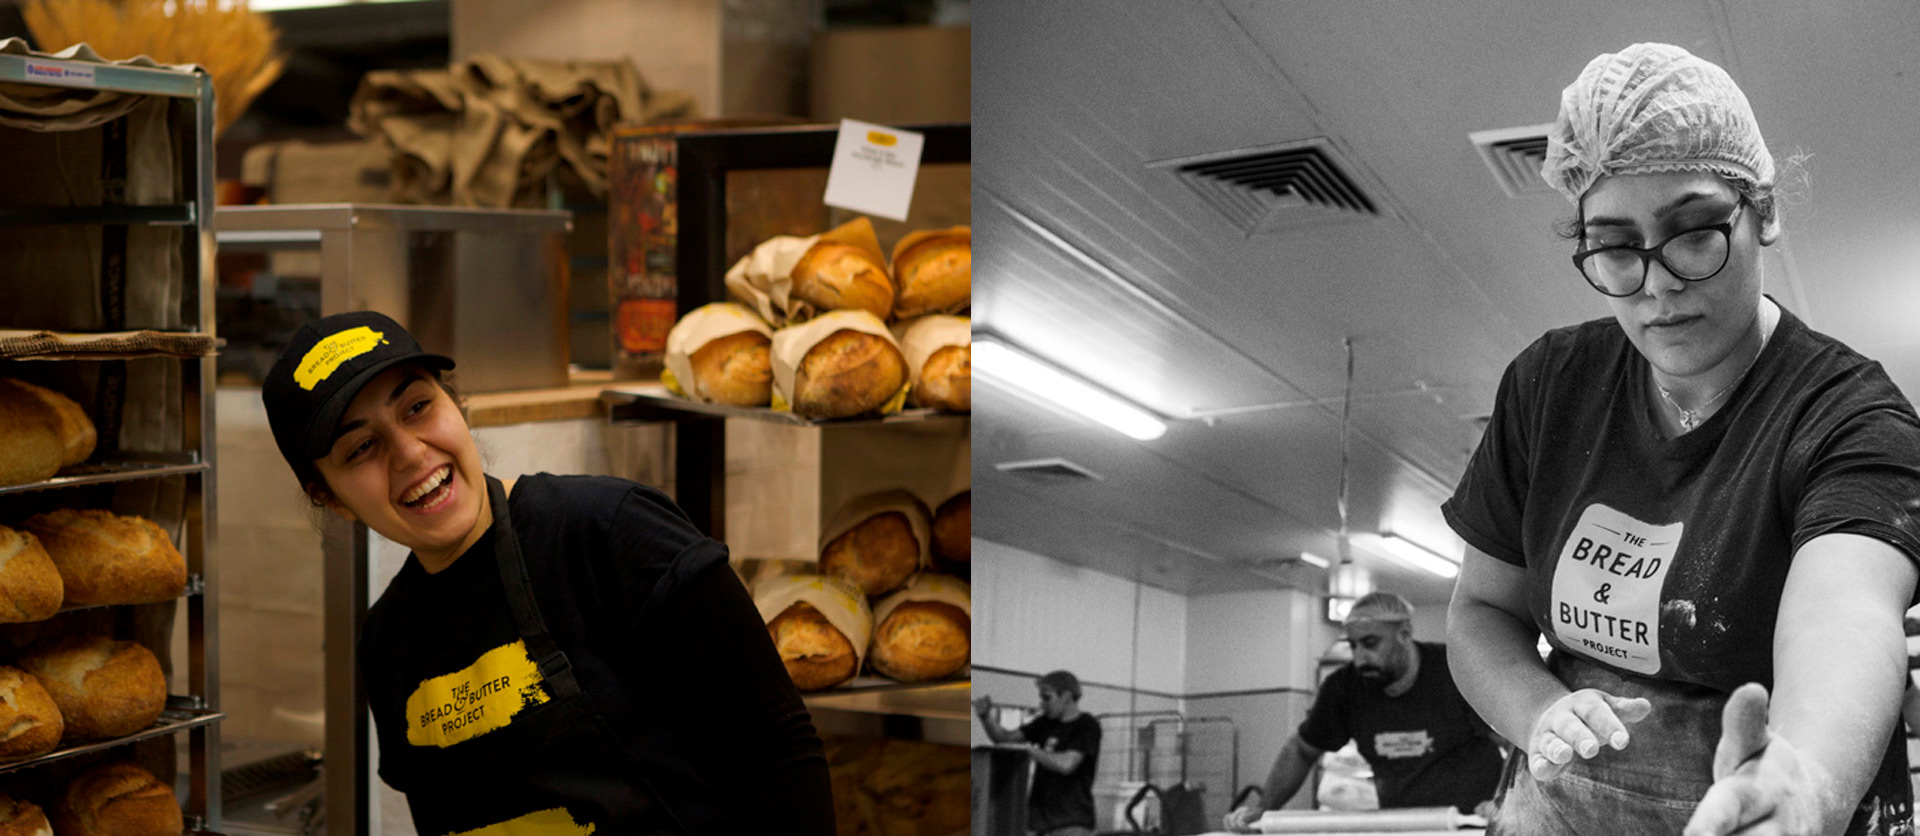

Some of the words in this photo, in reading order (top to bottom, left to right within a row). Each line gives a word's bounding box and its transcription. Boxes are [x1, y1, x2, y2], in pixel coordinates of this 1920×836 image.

[308, 352, 330, 374] BREAD
[339, 335, 366, 348] BUTTER
[325, 346, 355, 366] PROJECT
[1623, 532, 1647, 548] THE
[1572, 537, 1661, 579] BREAD
[1593, 583, 1612, 605] &
[1560, 601, 1650, 646] BUTTER
[1582, 638, 1628, 660] PROJECT
[420, 702, 453, 728] BREAD
[454, 691, 470, 713] &
[469, 675, 511, 705] BUTTER
[451, 681, 470, 700] THE
[441, 705, 485, 735] PROJECT
